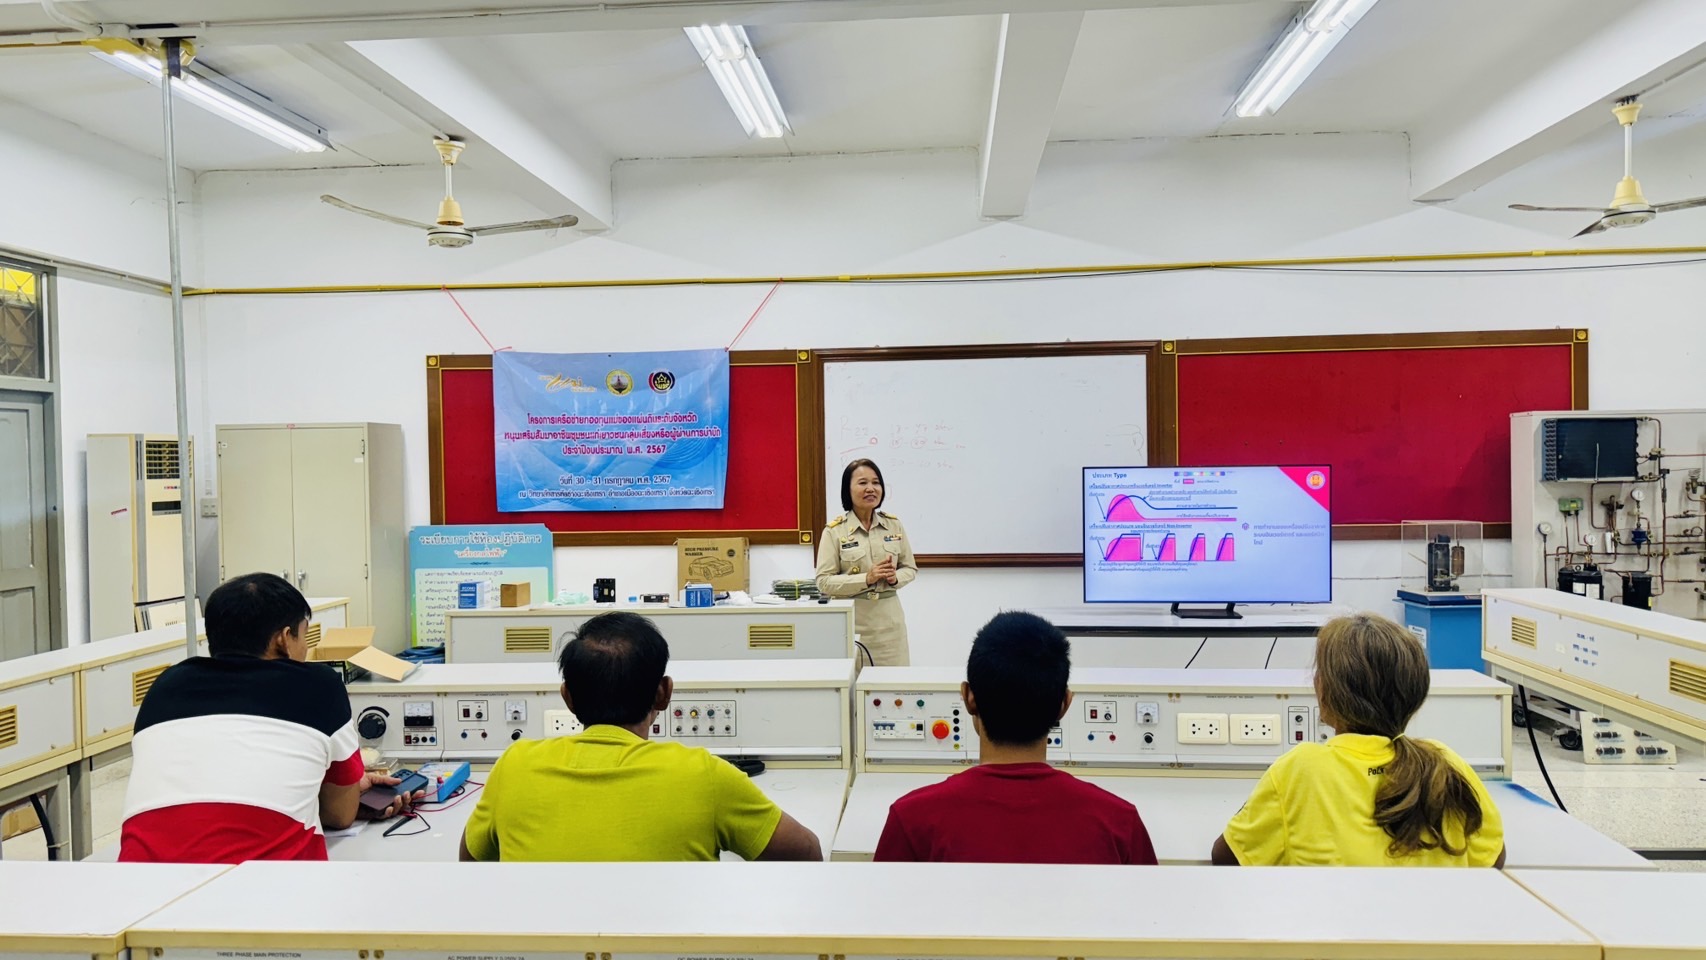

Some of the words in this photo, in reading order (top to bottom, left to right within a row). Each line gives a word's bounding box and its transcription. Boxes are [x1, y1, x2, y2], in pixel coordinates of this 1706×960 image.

[563, 444, 623, 455] ประจำปีงบประมาณ
[627, 446, 643, 454] พ.ศ.
[646, 445, 666, 454] 2567
[560, 474, 573, 484] วันที่
[604, 477, 634, 486] กรกฎาคม
[653, 476, 671, 484] 2567
[419, 532, 541, 546] ระเบียบการใช้ห้องปฏิบัติการ
